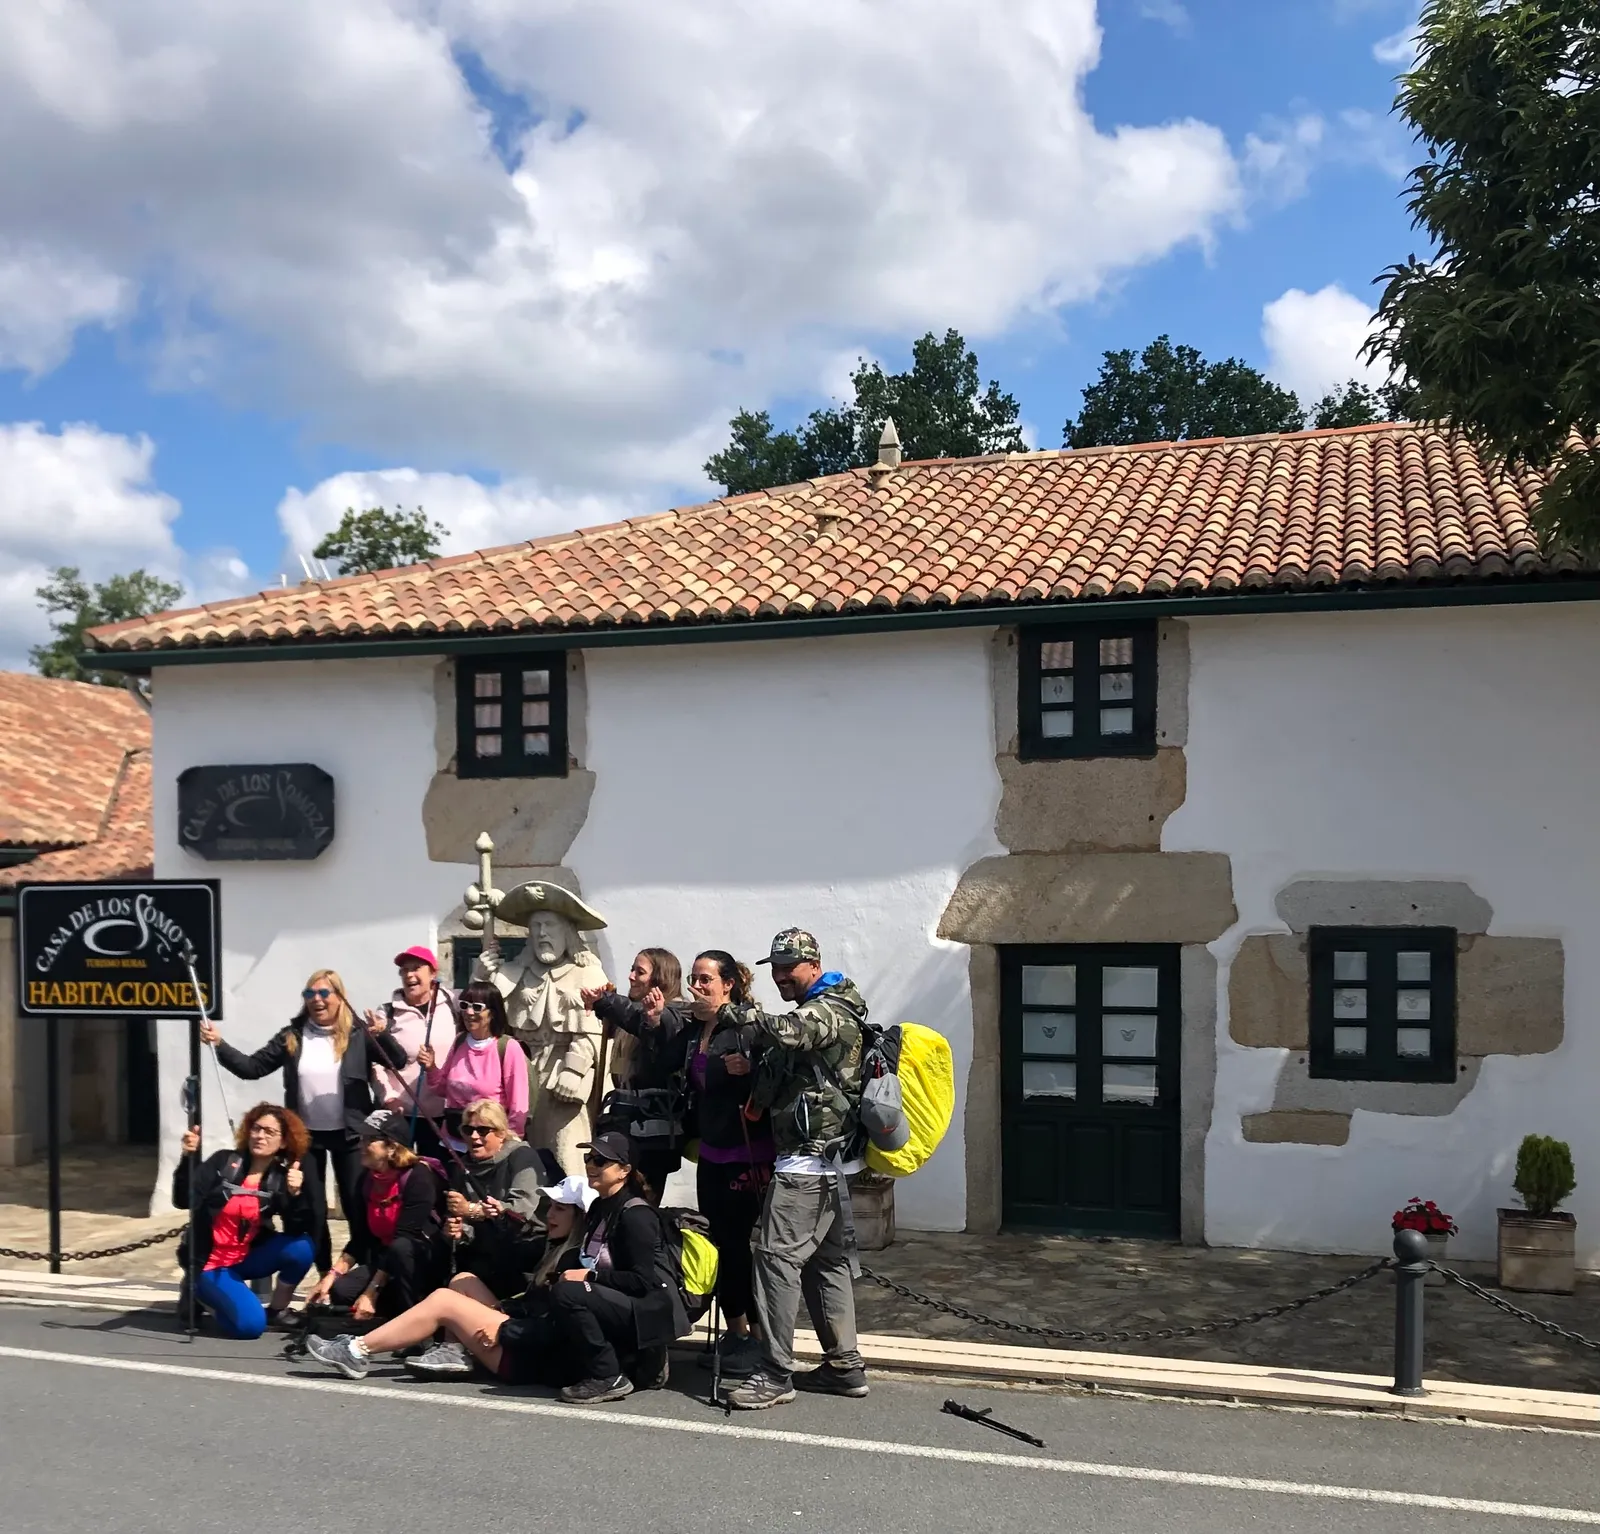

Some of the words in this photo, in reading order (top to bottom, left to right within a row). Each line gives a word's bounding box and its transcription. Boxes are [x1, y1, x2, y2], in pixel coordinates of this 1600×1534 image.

[183, 799, 218, 841] CASA
[216, 779, 240, 801] DE
[241, 773, 272, 793] LOS
[36, 926, 72, 973] CASA
[69, 903, 96, 931] DE
[97, 897, 132, 917] LOS
[29, 981, 208, 1007] HABITACIONES
